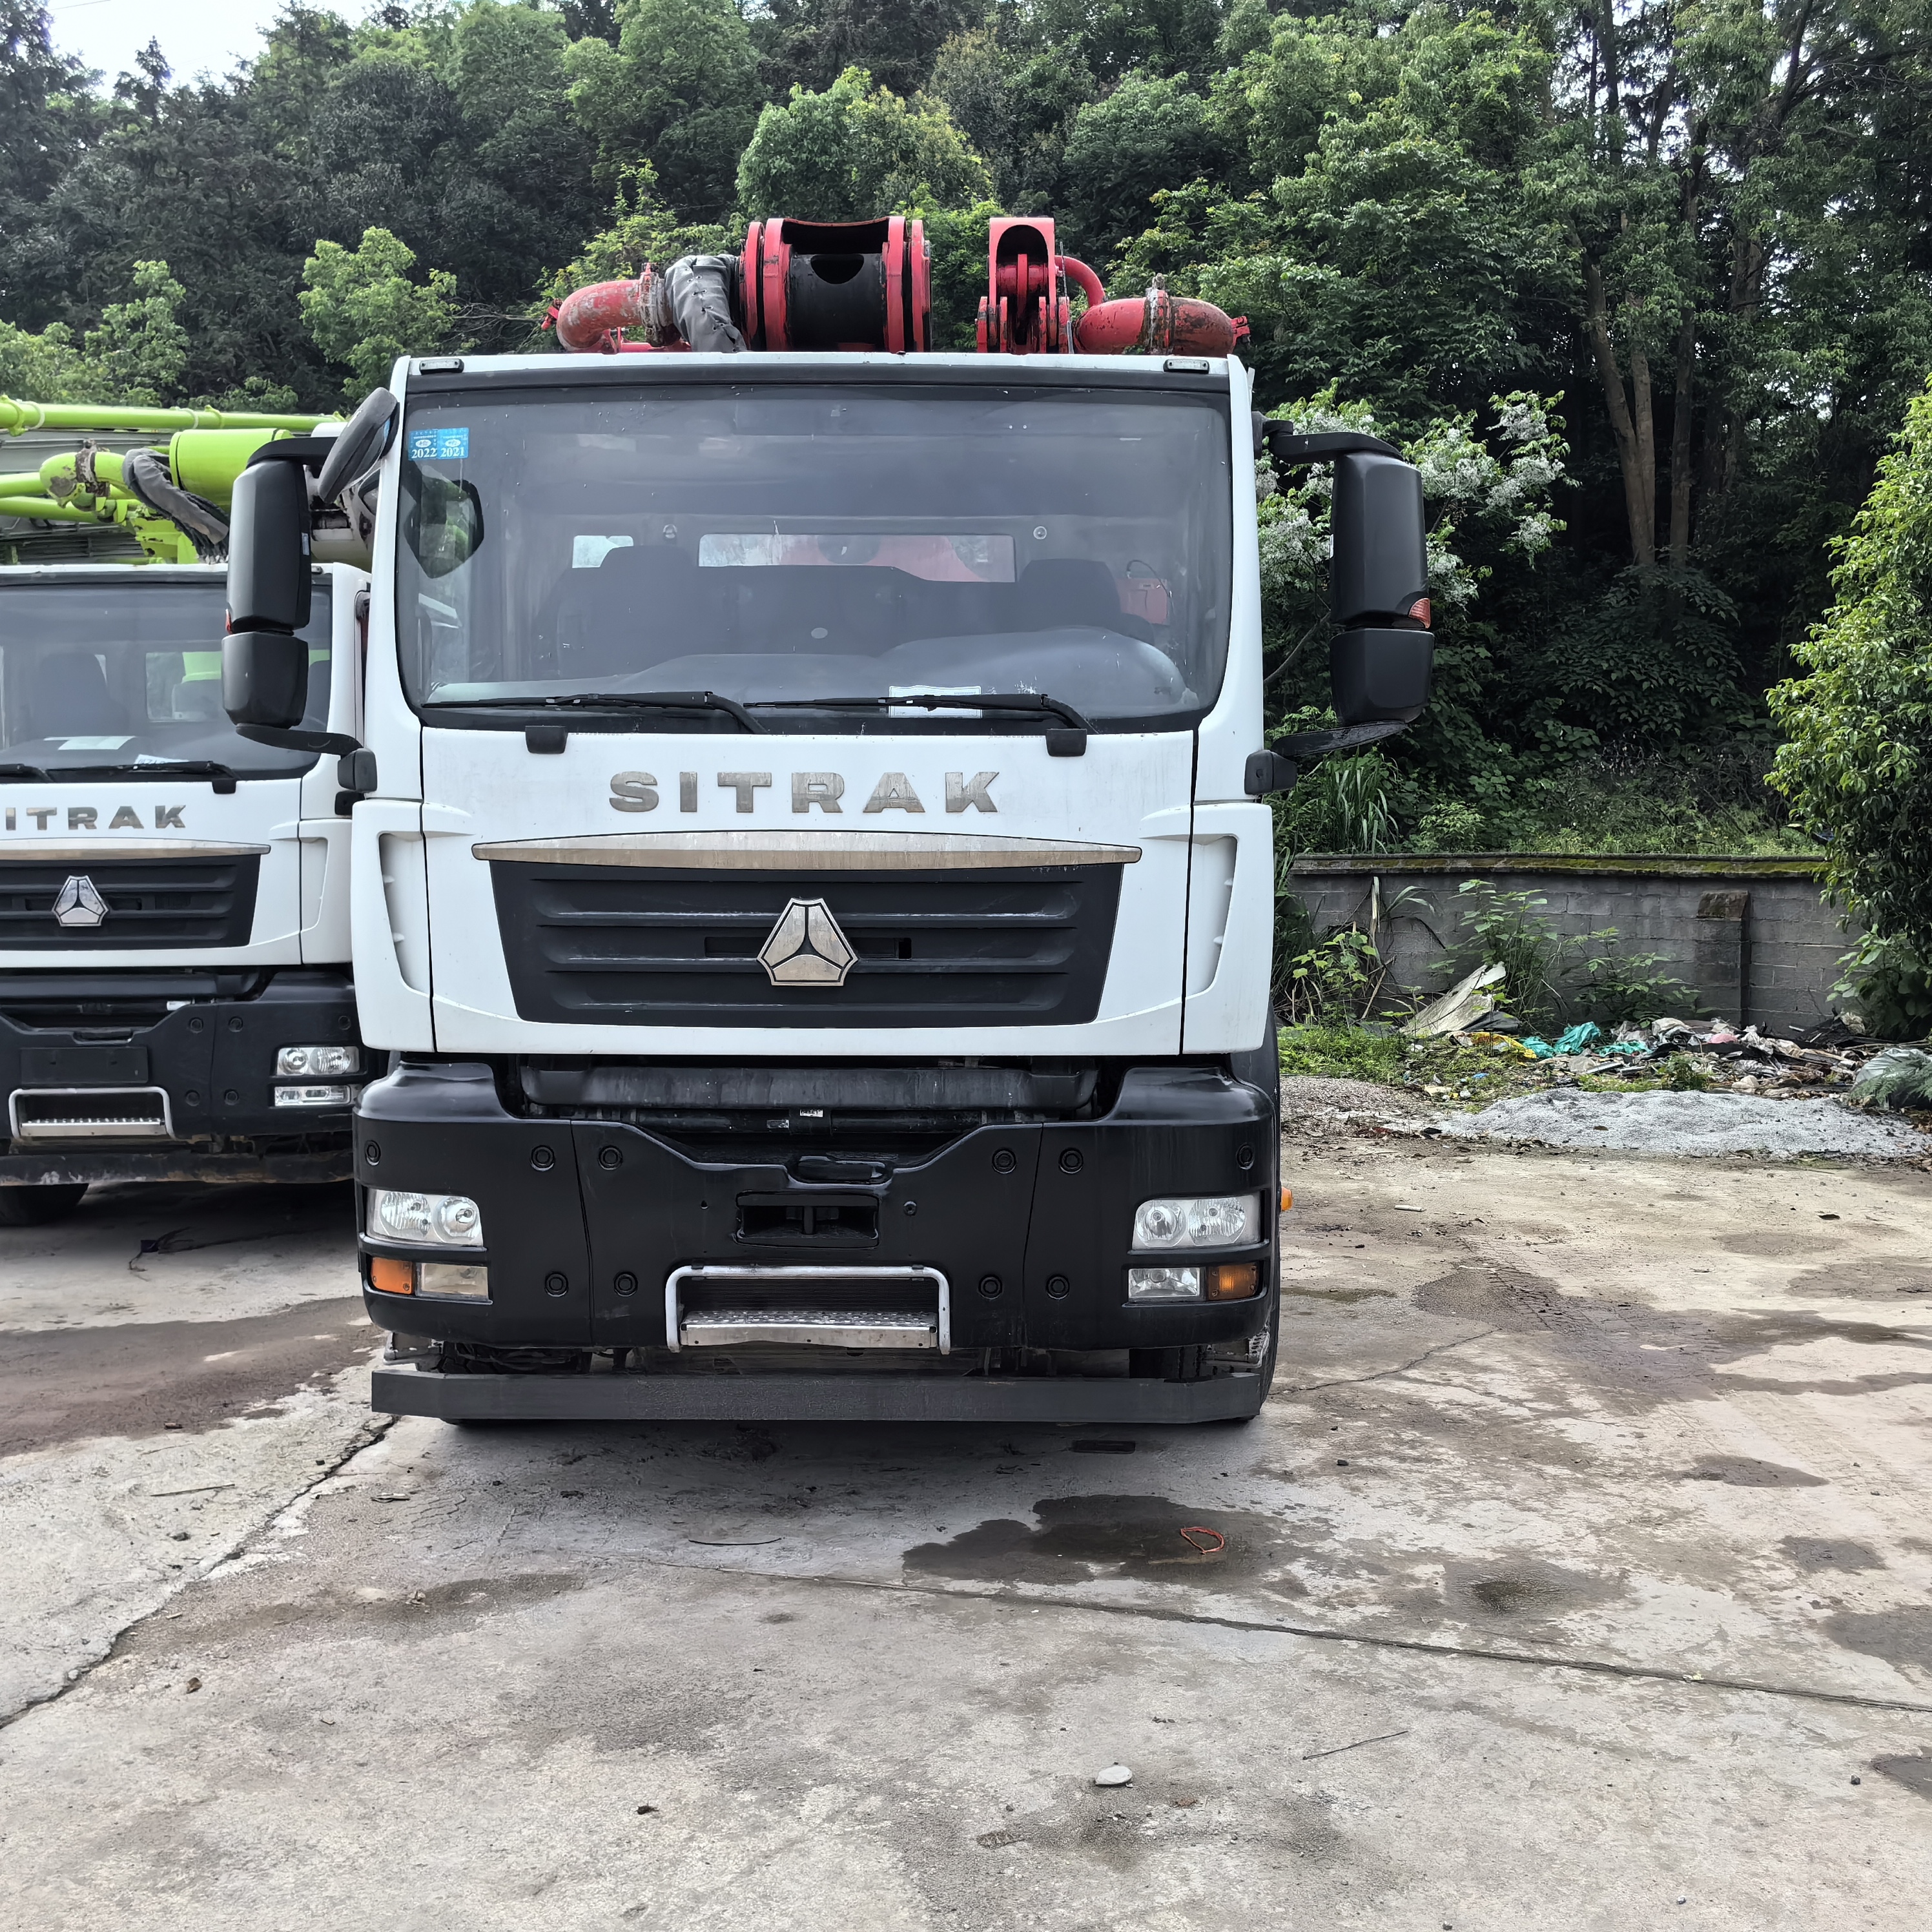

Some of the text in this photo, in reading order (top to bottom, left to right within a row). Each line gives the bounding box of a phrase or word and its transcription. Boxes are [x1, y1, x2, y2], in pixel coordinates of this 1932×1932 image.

[411, 447, 437, 458] 2022
[440, 447, 464, 457] 2021
[610, 771, 1000, 812] SITRAK
